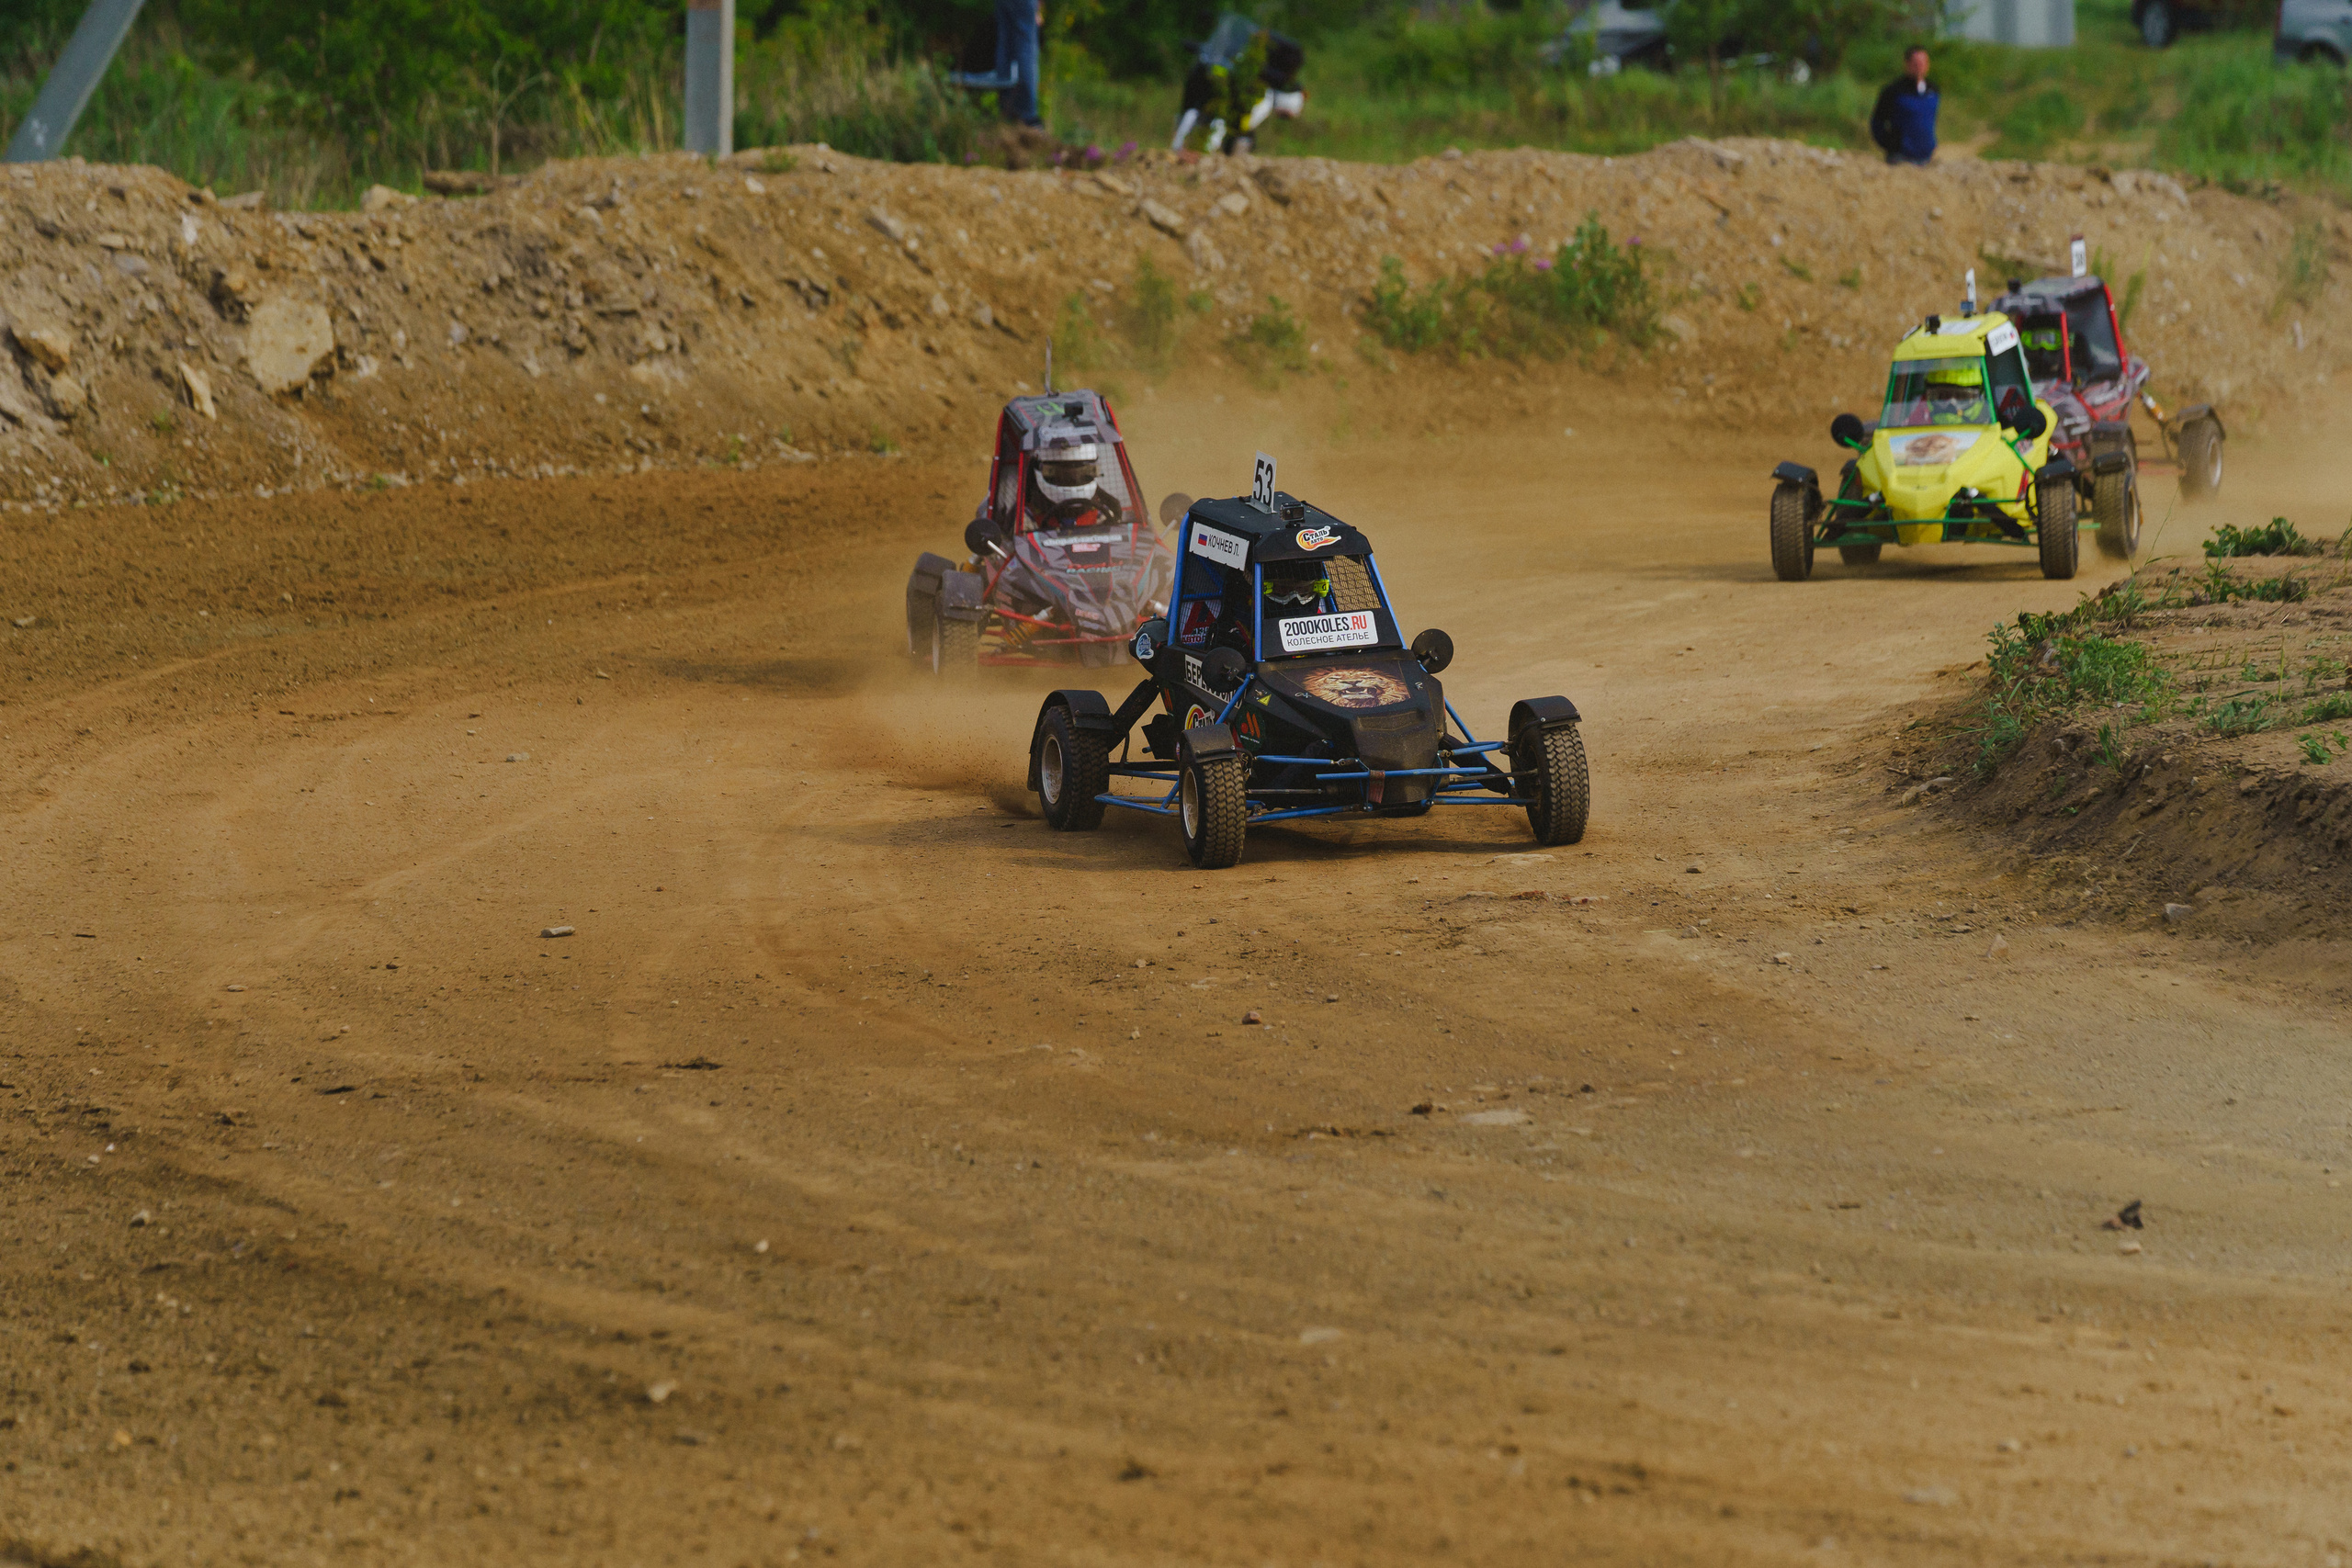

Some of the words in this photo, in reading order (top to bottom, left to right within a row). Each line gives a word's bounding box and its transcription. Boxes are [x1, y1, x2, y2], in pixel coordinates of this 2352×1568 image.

[1253, 459, 1273, 505] 53
[1207, 534, 1233, 554] КОЧНЕВ
[1284, 615, 1368, 637] 2000KOLES.RU
[1287, 635, 1334, 647] КОЛЕСНОЕ
[1337, 632, 1369, 642] АТЕЛЬЕ
